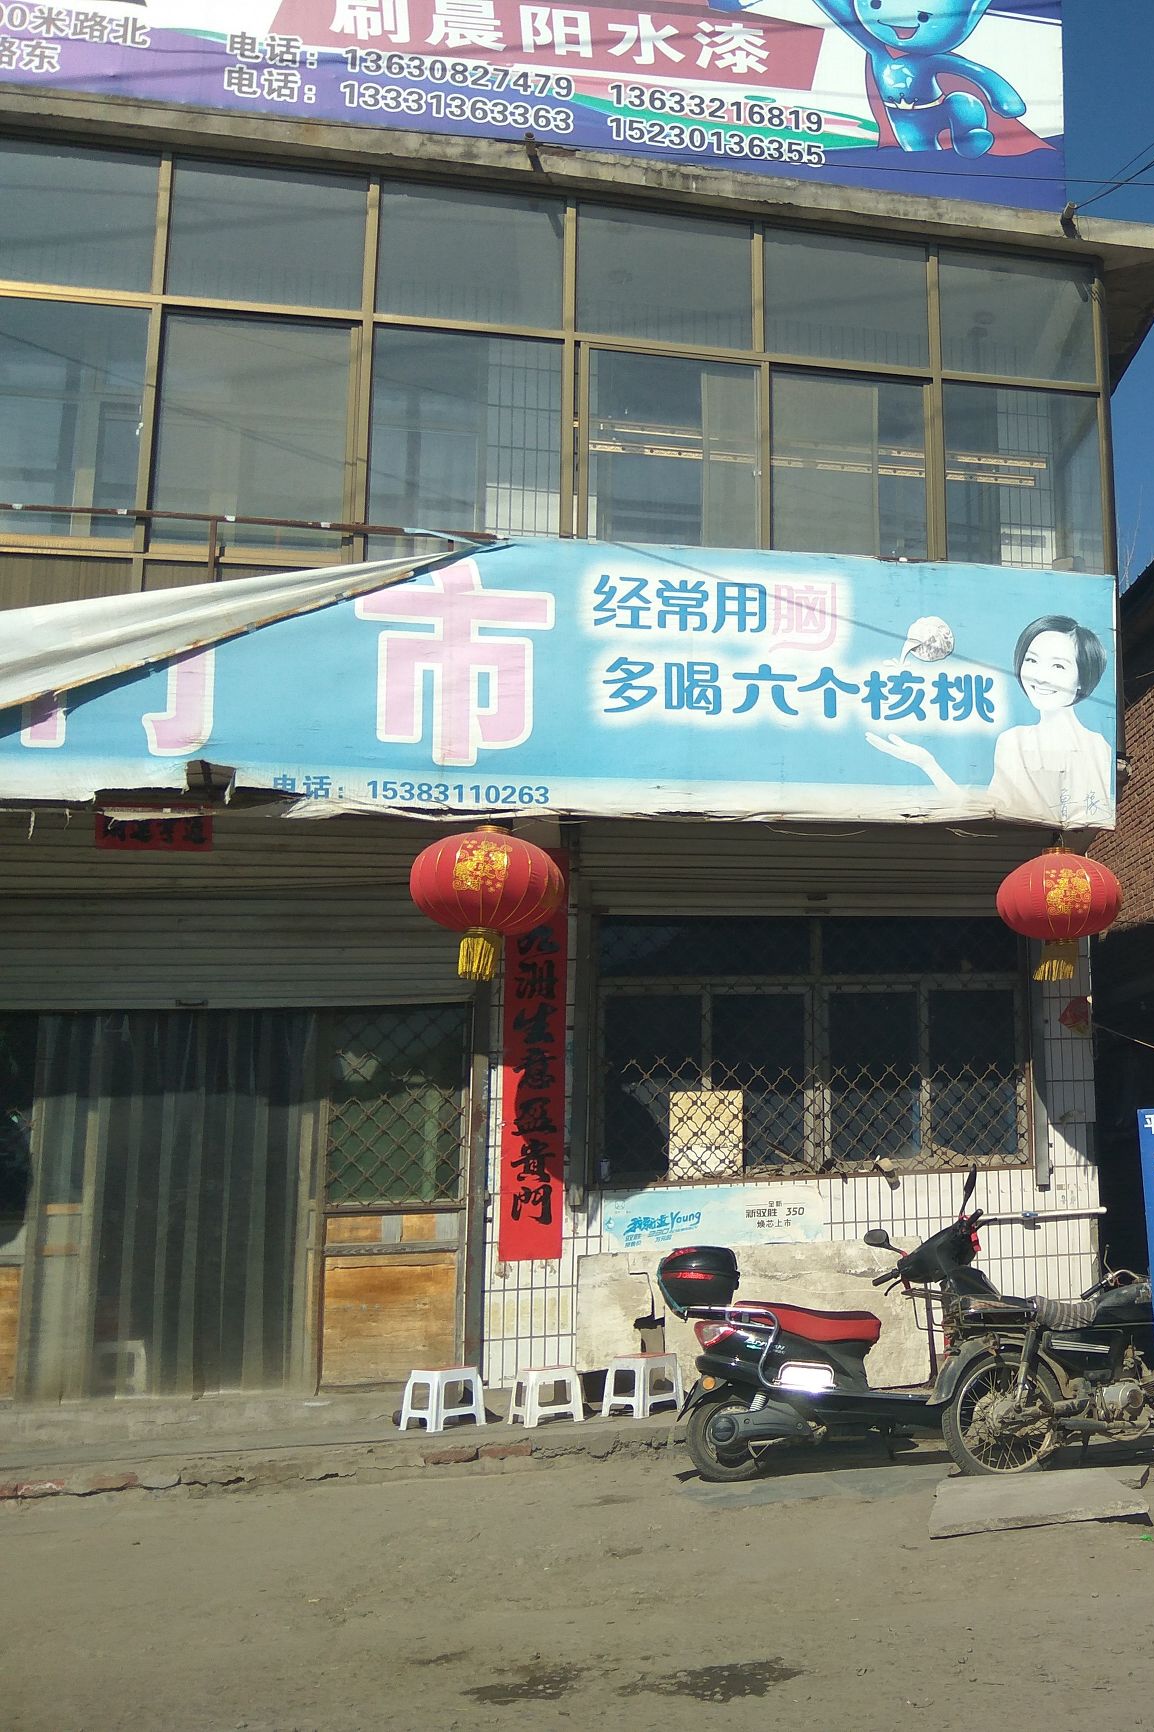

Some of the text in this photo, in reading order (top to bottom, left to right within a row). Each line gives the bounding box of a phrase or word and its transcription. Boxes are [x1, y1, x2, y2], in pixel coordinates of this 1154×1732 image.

[0, 3, 148, 46] 0米路北
[229, 32, 824, 134] 电话： 13630827479 13633216819
[227, 67, 826, 167] 电话： 13331363363 15230136355
[593, 575, 837, 654] 经常用脑
[603, 657, 995, 723] 多喝六个核桃
[366, 780, 550, 805] 15383110263
[785, 1207, 805, 1217] 350
